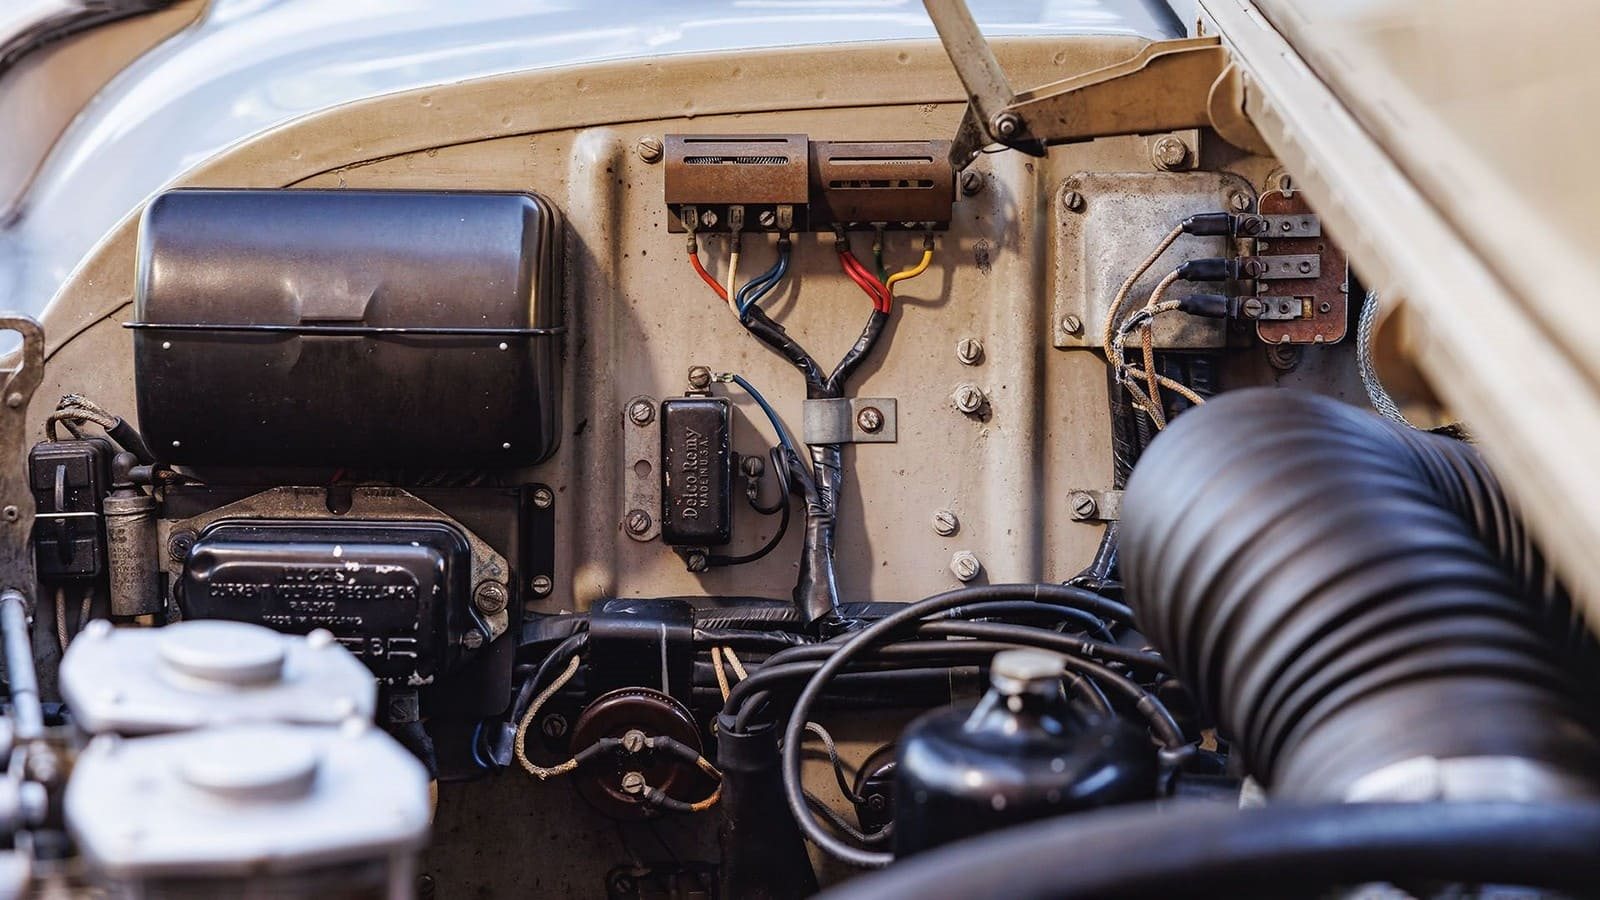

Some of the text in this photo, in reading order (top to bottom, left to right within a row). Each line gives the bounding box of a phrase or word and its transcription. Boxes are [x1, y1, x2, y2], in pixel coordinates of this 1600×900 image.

[682, 426, 702, 519] Delco Remy
[699, 468, 709, 478] IN
[699, 480, 709, 508] MADE
[210, 583, 416, 599] CURRENT VOLTAGE REGULATOR
